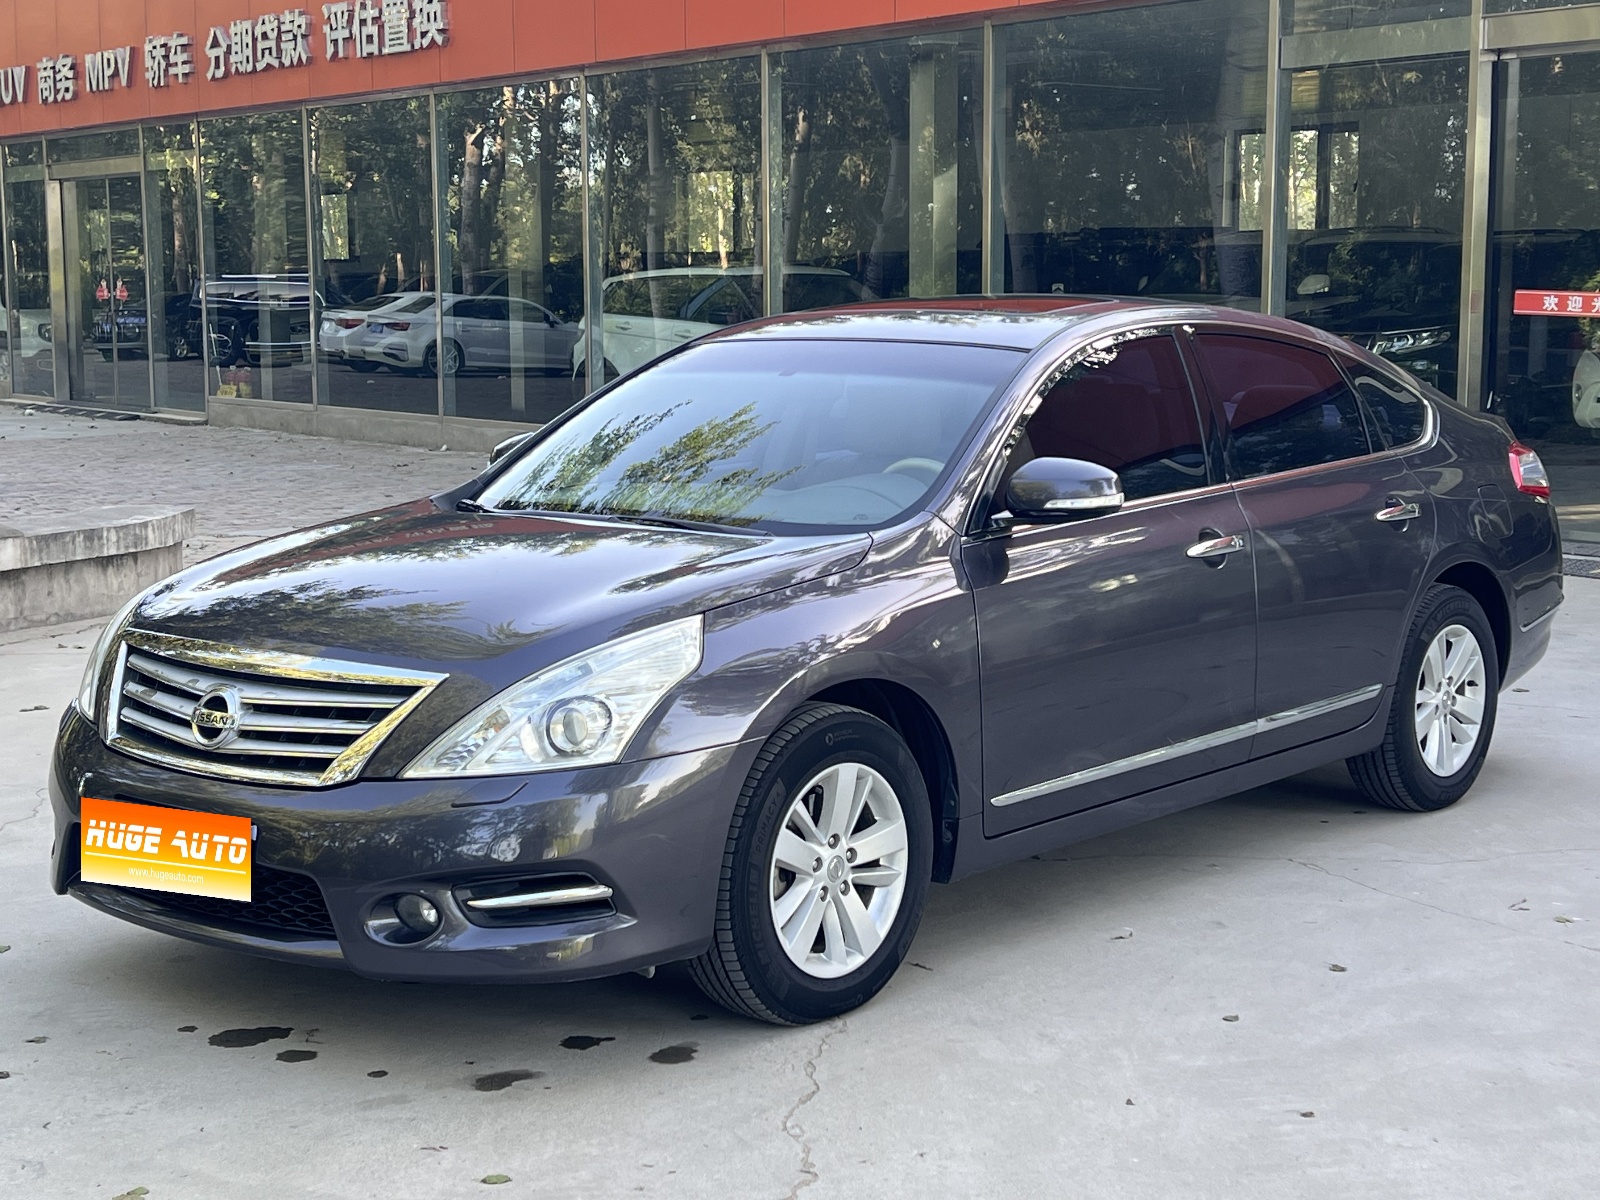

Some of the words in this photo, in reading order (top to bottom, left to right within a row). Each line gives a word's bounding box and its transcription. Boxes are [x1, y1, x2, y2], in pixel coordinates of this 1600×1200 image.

[36, 54, 75, 104] 商务
[85, 46, 131, 92] MPV
[144, 32, 190, 87] 轿车
[205, 9, 309, 81] 分期贷款
[322, 0, 443, 61] 评估置换
